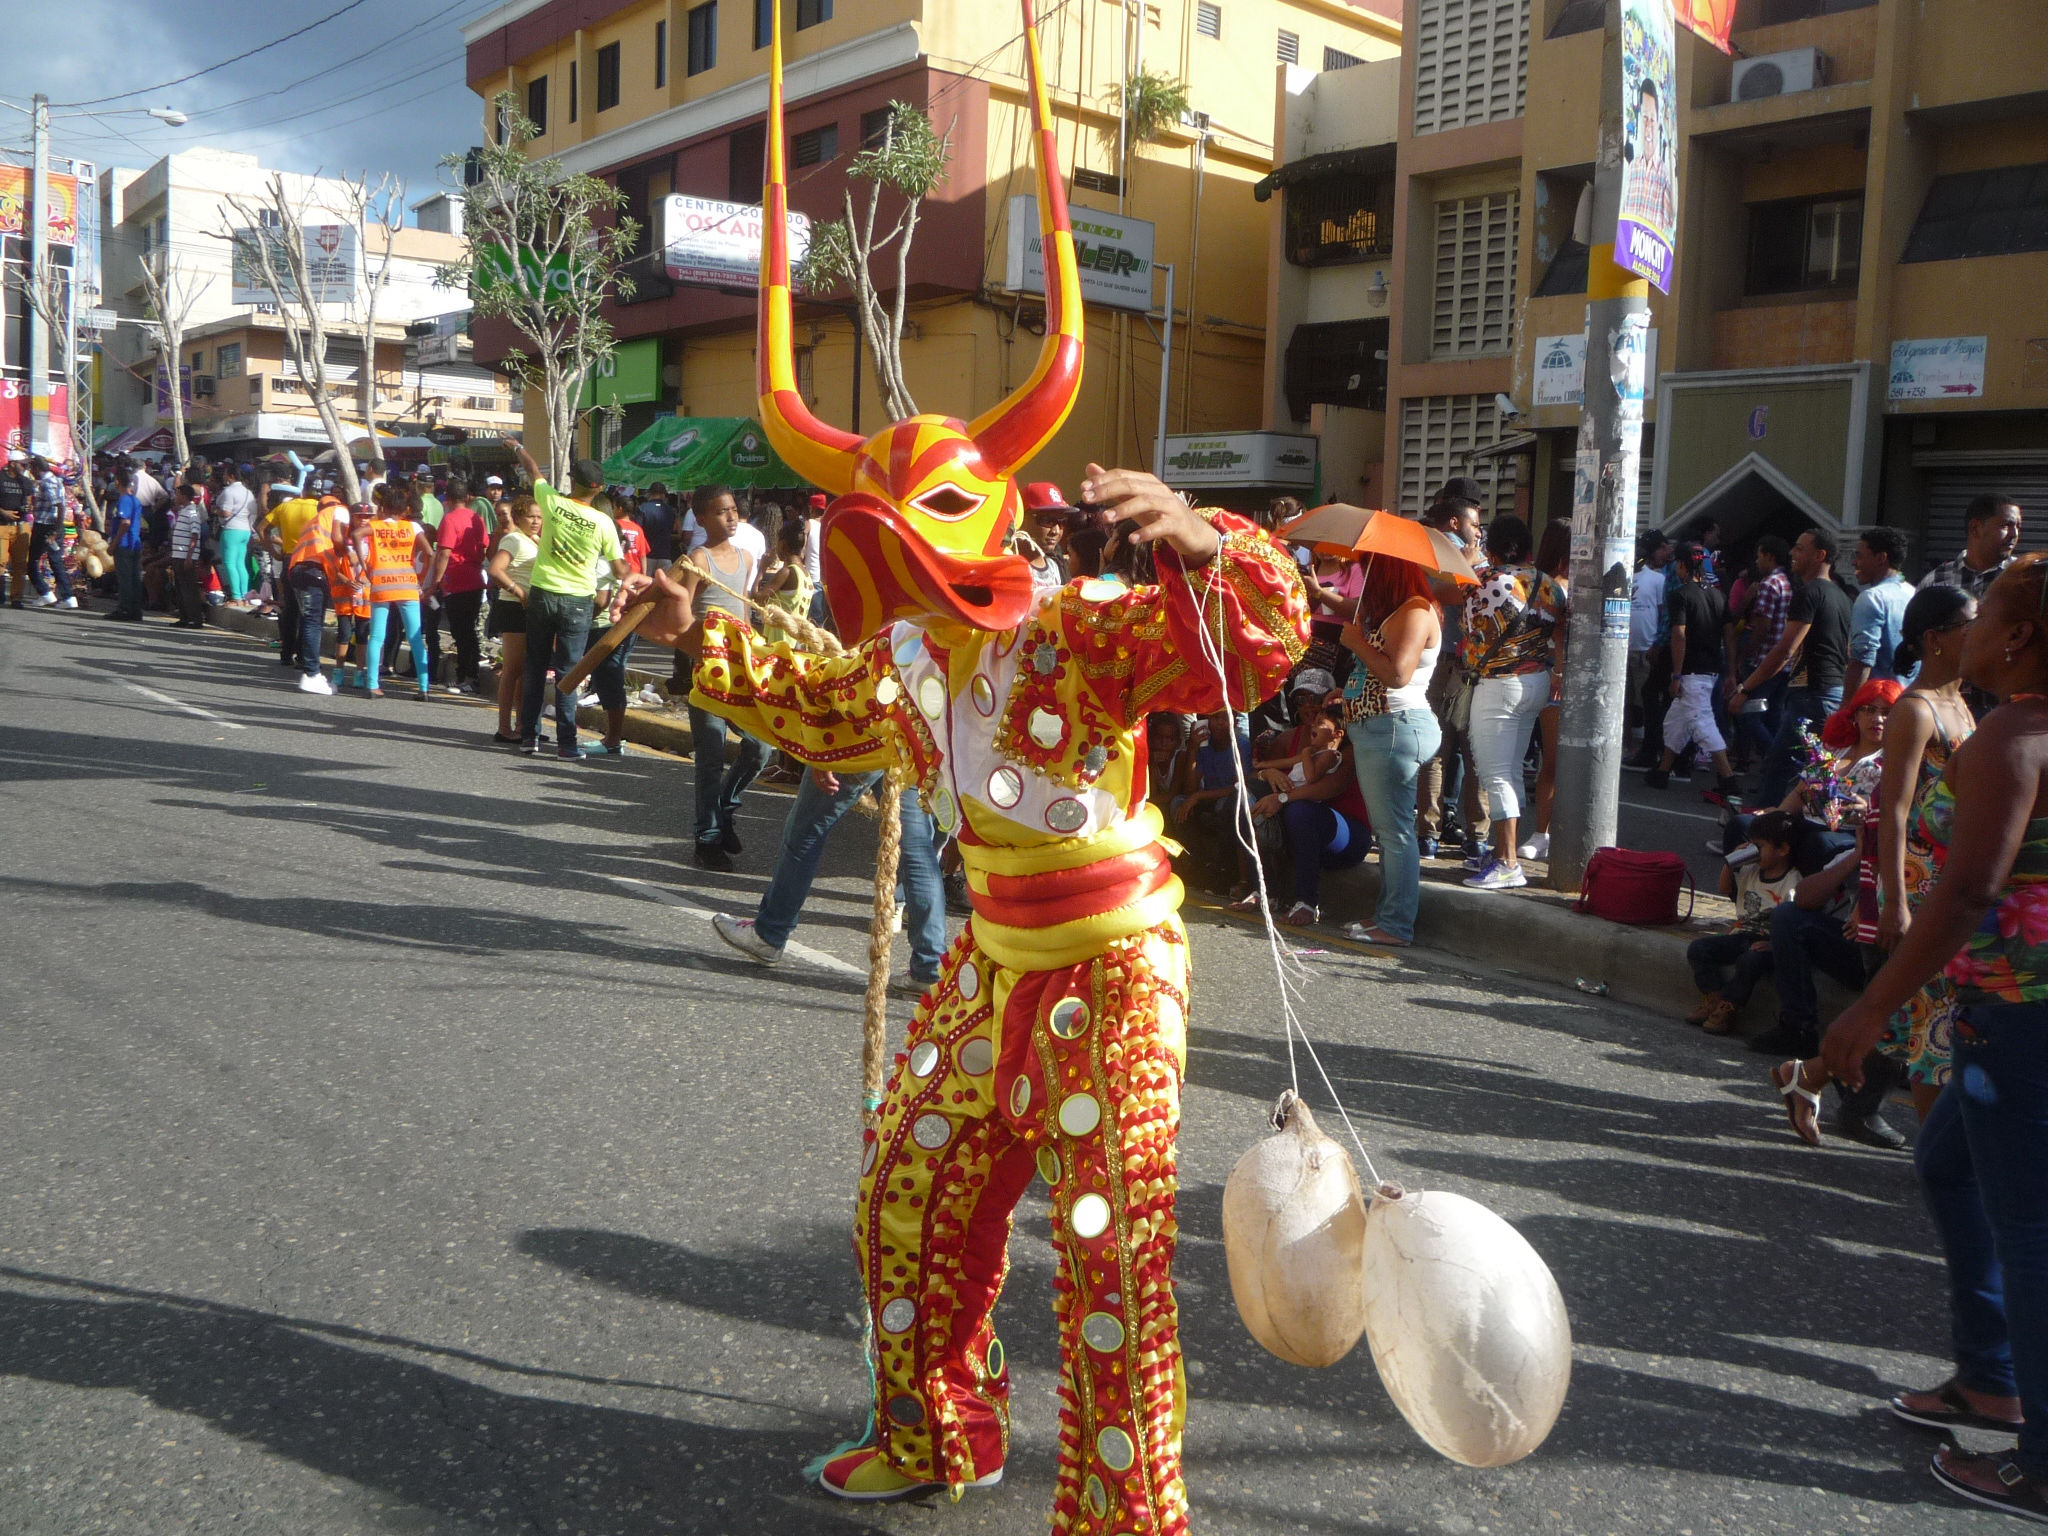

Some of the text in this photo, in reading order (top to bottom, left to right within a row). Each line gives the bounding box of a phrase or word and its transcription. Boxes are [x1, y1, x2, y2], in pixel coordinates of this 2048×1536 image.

[675, 197, 735, 215] CENTRO
[1630, 226, 1666, 273] MONCHY
[1177, 451, 1235, 469] SILER
[555, 506, 596, 530] mazda
